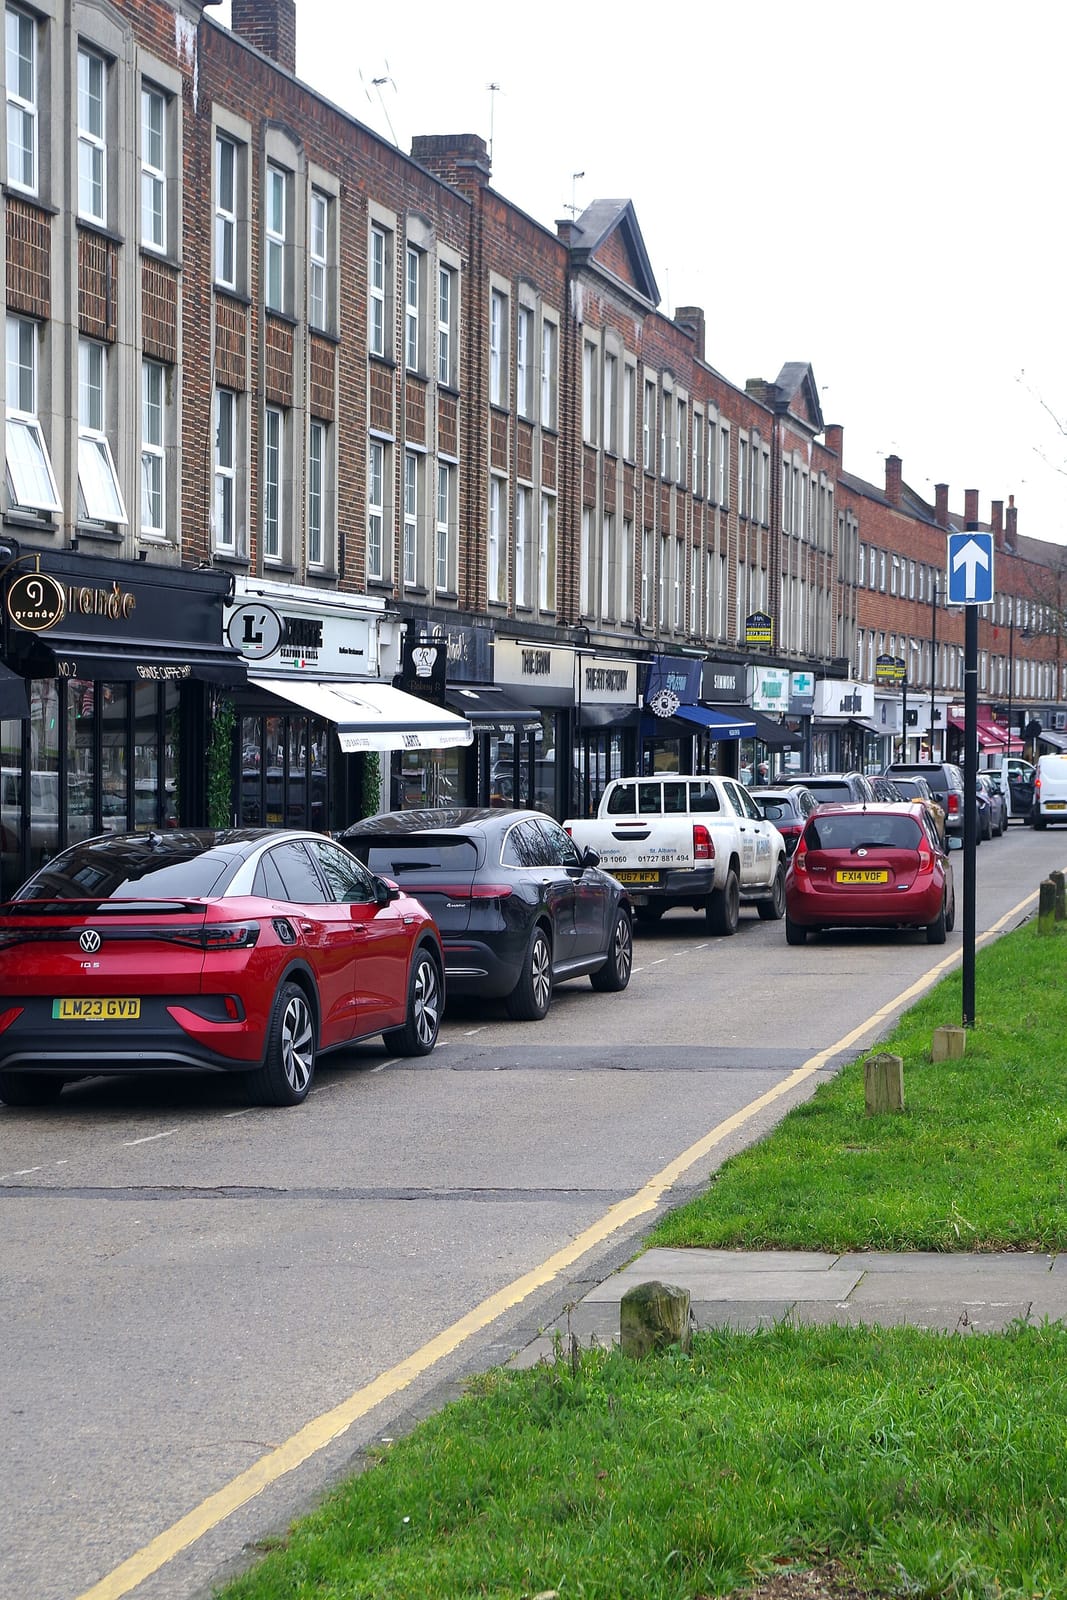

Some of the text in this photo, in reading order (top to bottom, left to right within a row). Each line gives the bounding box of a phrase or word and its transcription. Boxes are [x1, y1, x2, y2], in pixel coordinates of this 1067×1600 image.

[15, 609, 55, 620] grande
[242, 615, 266, 643] L'
[72, 662, 77, 677] 2
[136, 665, 160, 680] GRANDE
[615, 872, 637, 881] CU67
[842, 871, 882, 881] FX14 VOF
[62, 1000, 138, 1016] LM23 GVD
